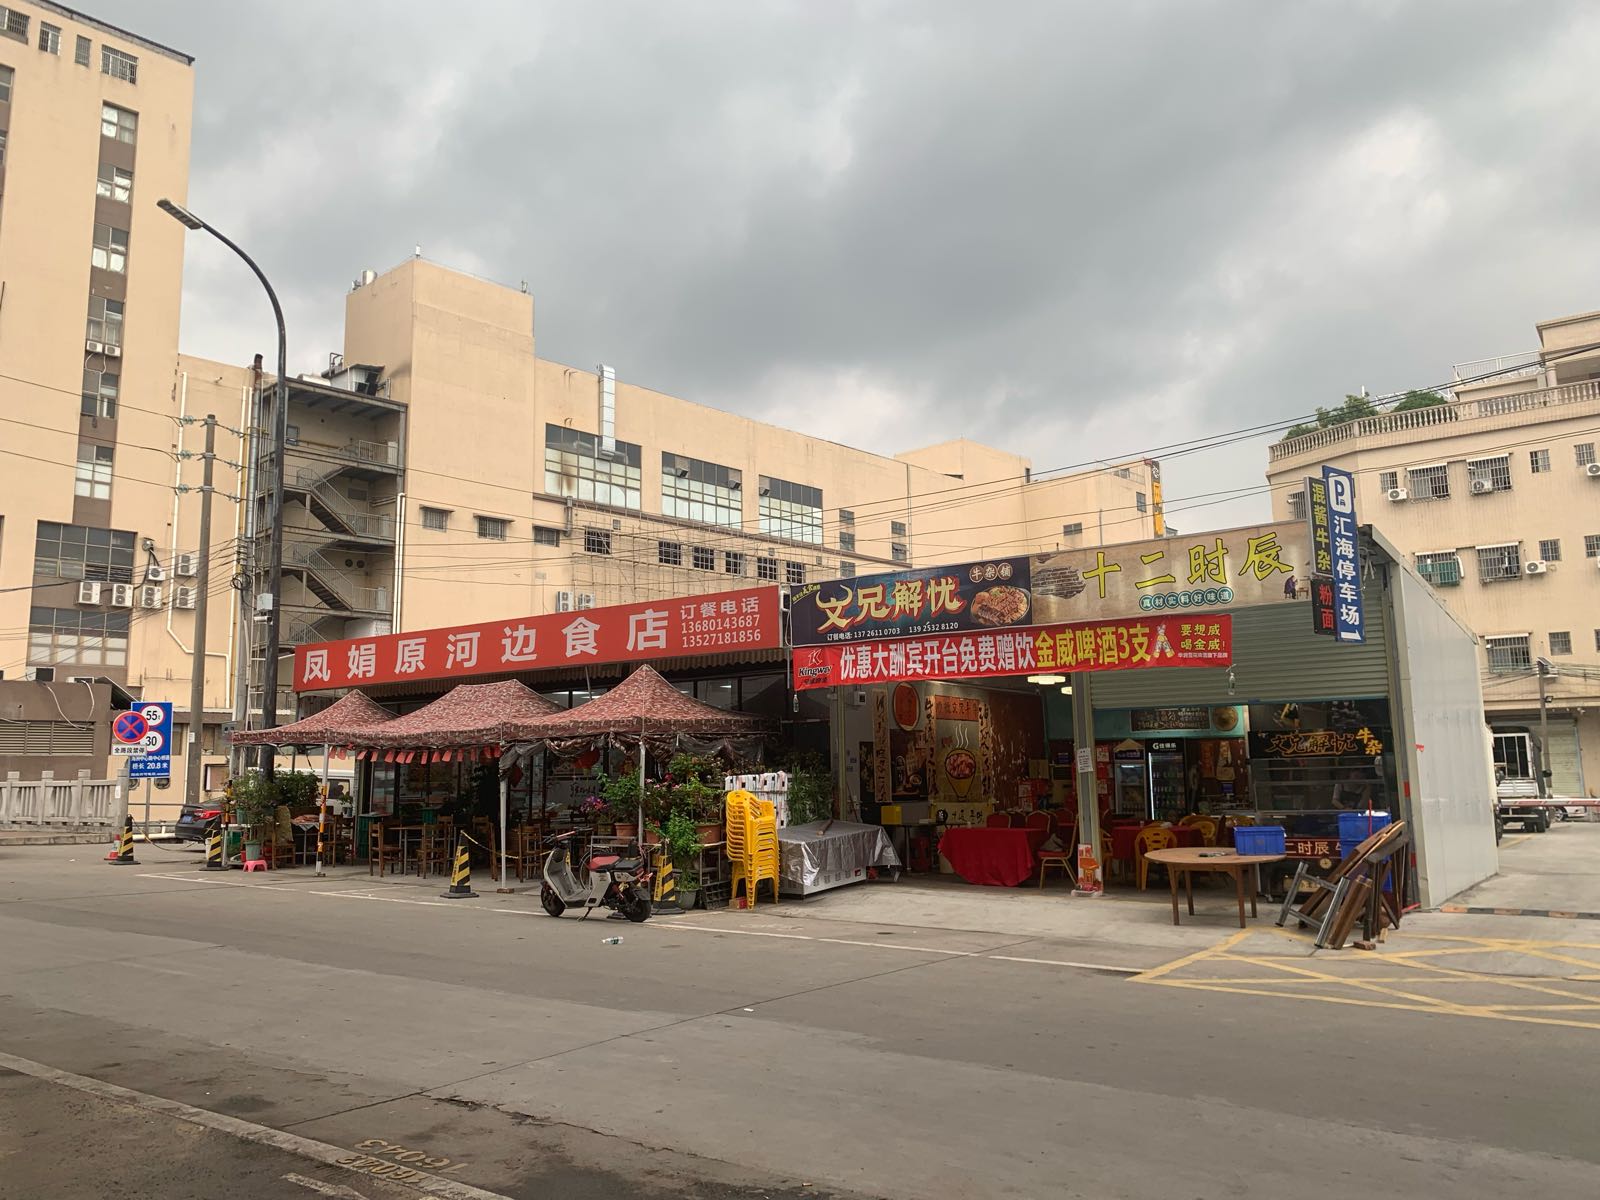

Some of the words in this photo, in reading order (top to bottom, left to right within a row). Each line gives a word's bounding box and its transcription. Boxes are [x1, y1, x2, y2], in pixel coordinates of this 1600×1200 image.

[970, 563, 1012, 581] 牛杂铺
[1082, 531, 1294, 599] 十二时辰
[1334, 515, 1360, 625] 汇海停车场
[680, 597, 760, 622] 订餐电话
[1319, 583, 1335, 629] 粉面
[681, 614, 761, 634] 13680143687
[1180, 623, 1221, 636] 要想威
[303, 609, 669, 684] 凤娟原河边食店
[682, 629, 762, 648] 13527181856
[839, 621, 1152, 681] 优惠大酬宾开台免费赠饮金威啤酒3支
[145, 736, 158, 746] 30
[1356, 727, 1383, 756] 牛杂
